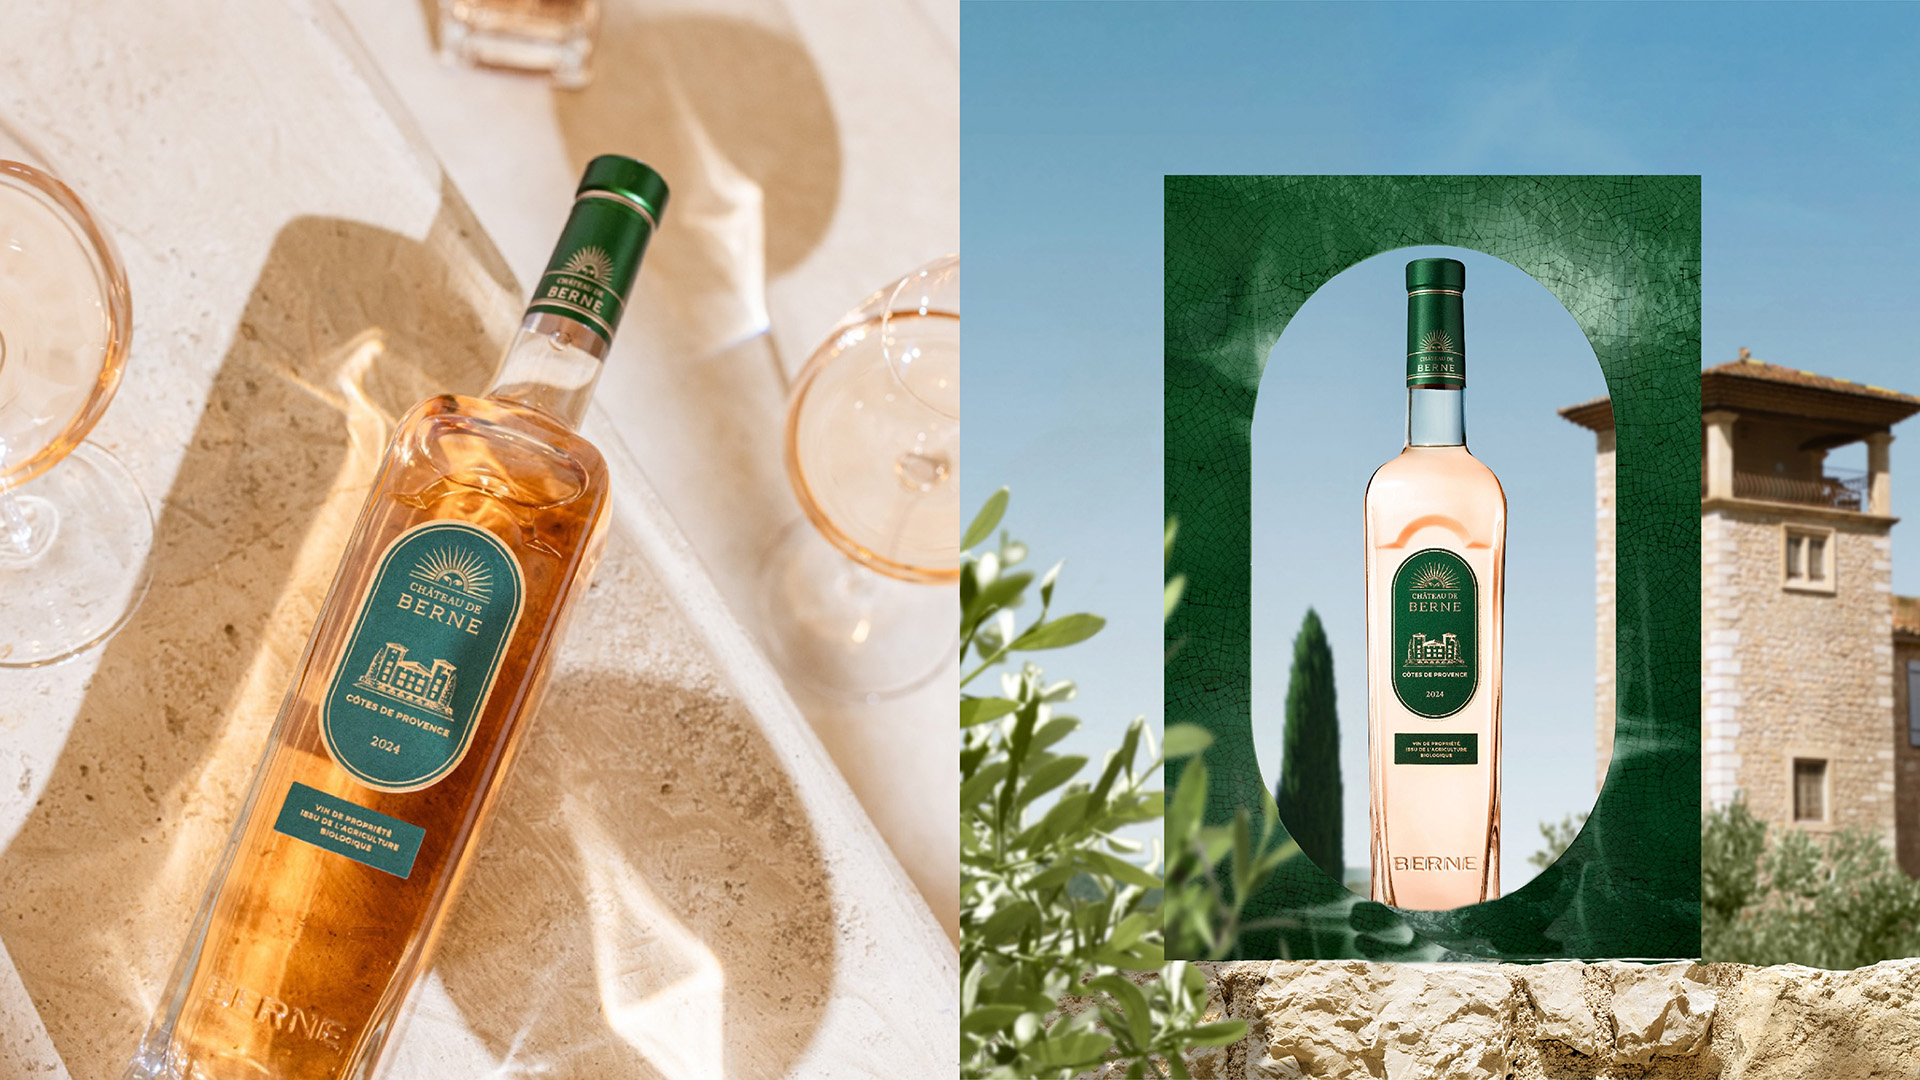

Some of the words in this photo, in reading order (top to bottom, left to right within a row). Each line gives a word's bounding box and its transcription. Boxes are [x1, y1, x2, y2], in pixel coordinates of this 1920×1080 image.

[547, 286, 604, 314] BERNE
[593, 288, 604, 298] DE
[409, 582, 464, 608] CHÂTEAU
[465, 602, 483, 614] DE
[1409, 601, 1462, 612] BERNE
[1411, 592, 1447, 600] CHÂTEAU
[397, 592, 483, 635] BERNE
[346, 693, 379, 711] CÔTES
[380, 706, 395, 717] DE
[395, 712, 450, 738] PROVENCE
[370, 736, 401, 755] 2024
[300, 809, 320, 822] ISSU
[321, 817, 333, 827] DE
[334, 821, 399, 851] L'AGRICULTURE
[315, 804, 330, 815] VIN
[332, 810, 344, 819] DE
[345, 815, 392, 838] PROPRIÉTÉ
[320, 827, 373, 852] BIOLOGIQUE
[1393, 856, 1477, 871] BERNE
